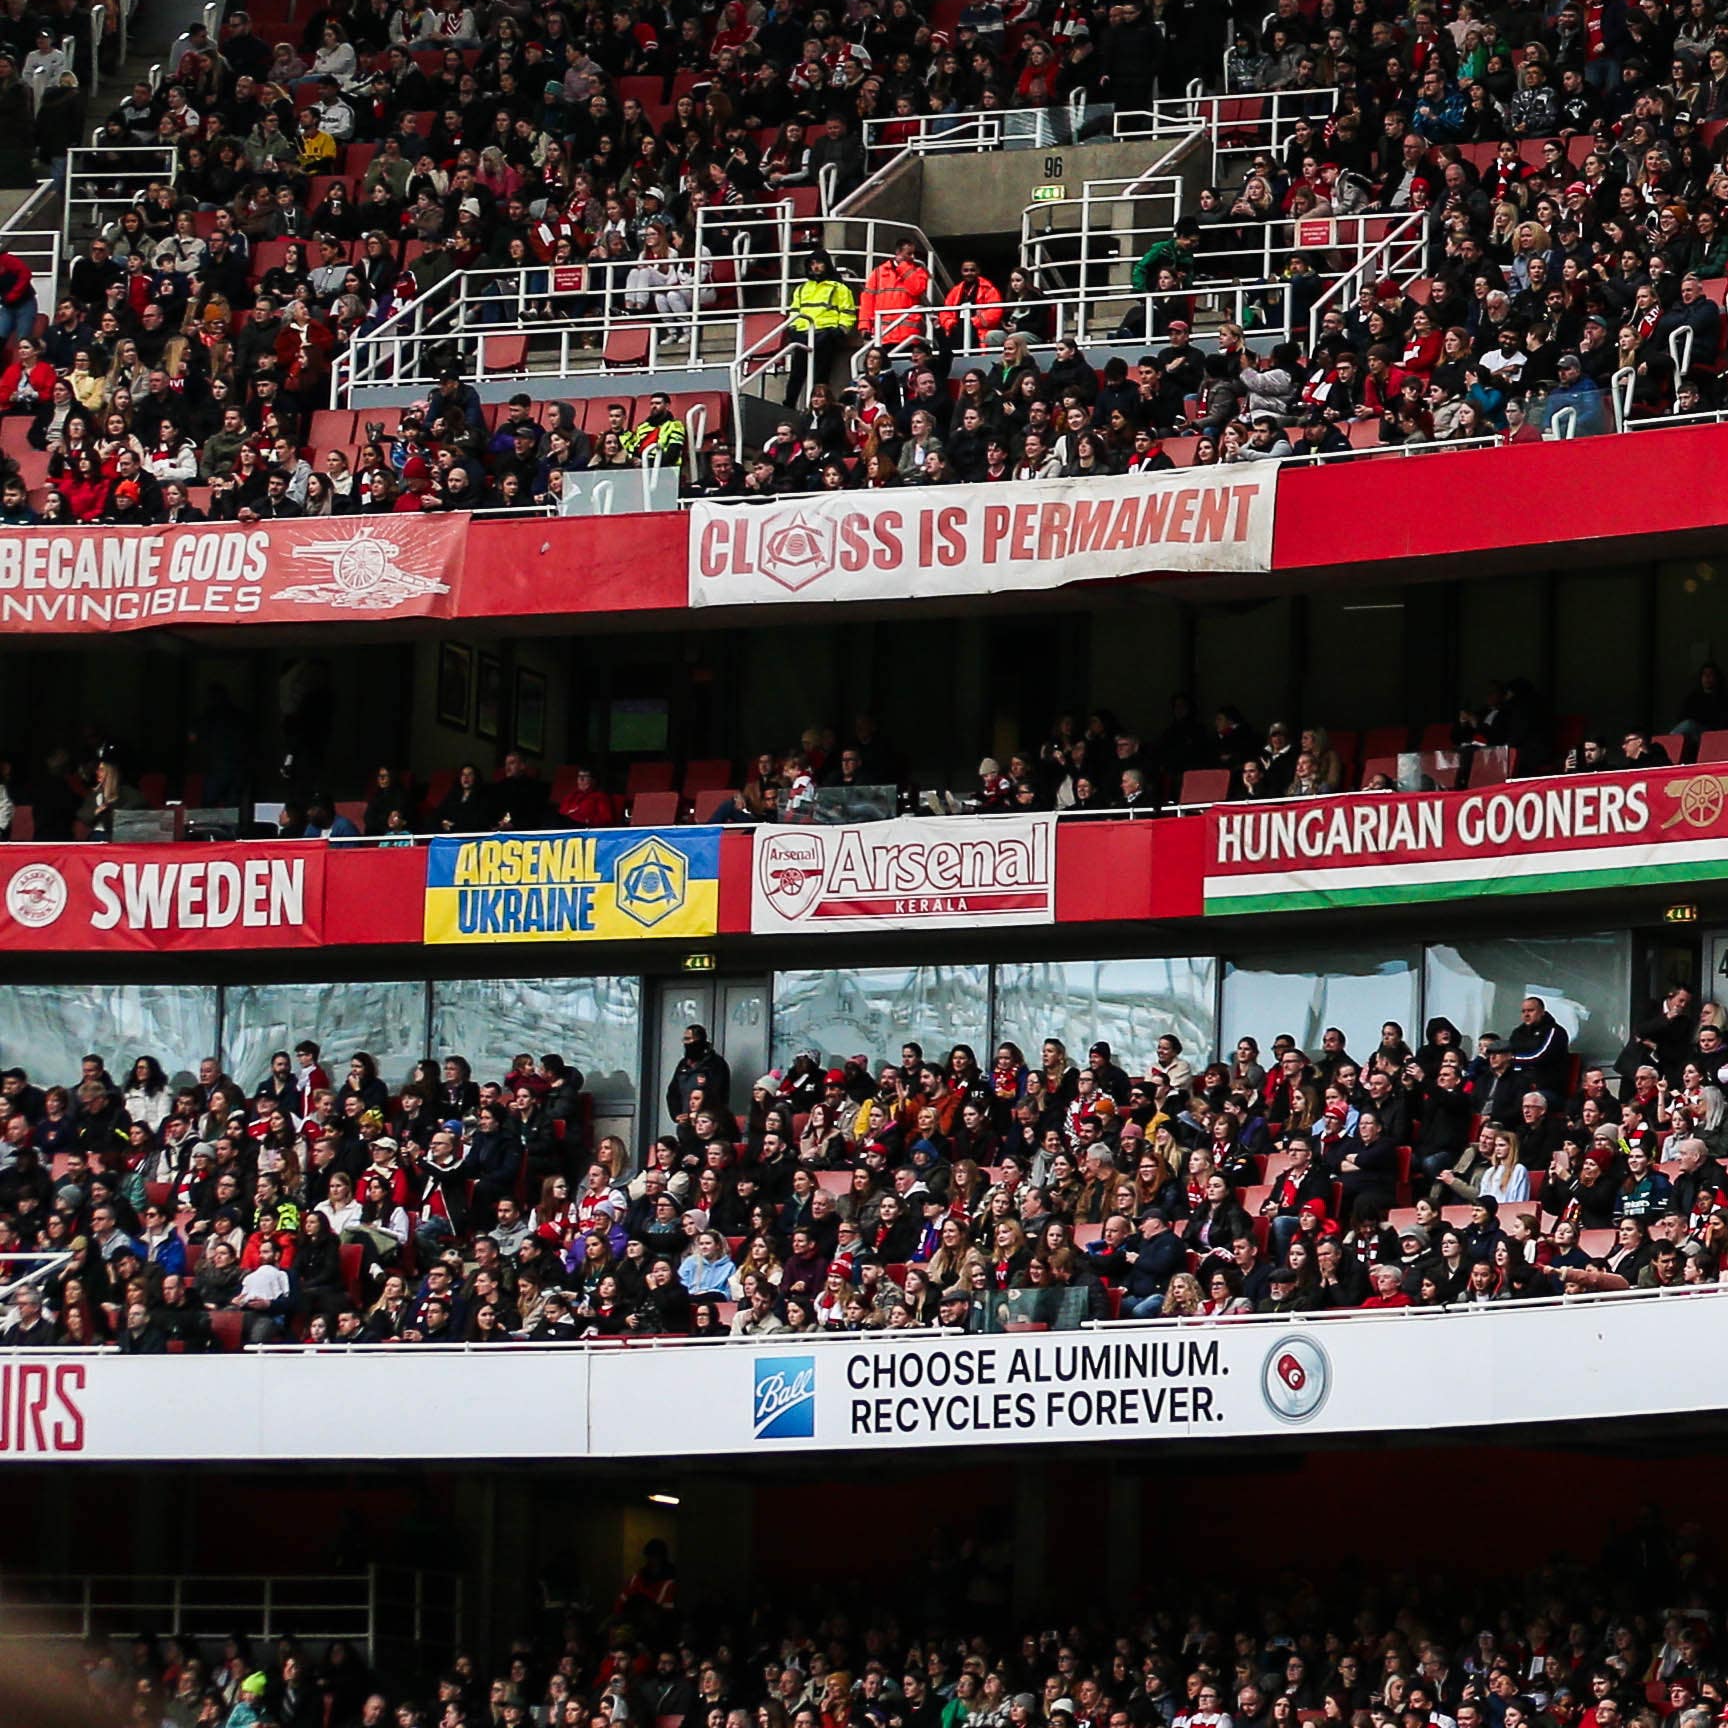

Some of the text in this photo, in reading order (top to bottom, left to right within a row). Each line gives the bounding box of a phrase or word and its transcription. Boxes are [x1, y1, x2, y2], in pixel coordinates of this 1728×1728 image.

[1044, 156, 1063, 178] 96
[919, 506, 968, 568] IS
[982, 483, 1260, 564] PERMANENT
[0, 530, 270, 589] BECAME GODS
[1217, 782, 1650, 864] HUNGARIAN GOONERS
[454, 837, 602, 886] ARSENAL
[770, 847, 816, 862] Arsenal
[827, 822, 1049, 894] Arsenal
[90, 859, 305, 930] SWEDEN
[458, 886, 596, 933] UKRAINE
[895, 896, 968, 914] KERALA
[847, 1340, 1230, 1390] CHOOSE ALUMINIUM.
[756, 1368, 814, 1418] Ball
[851, 1386, 1225, 1434] RECYCLES FOREVER.
